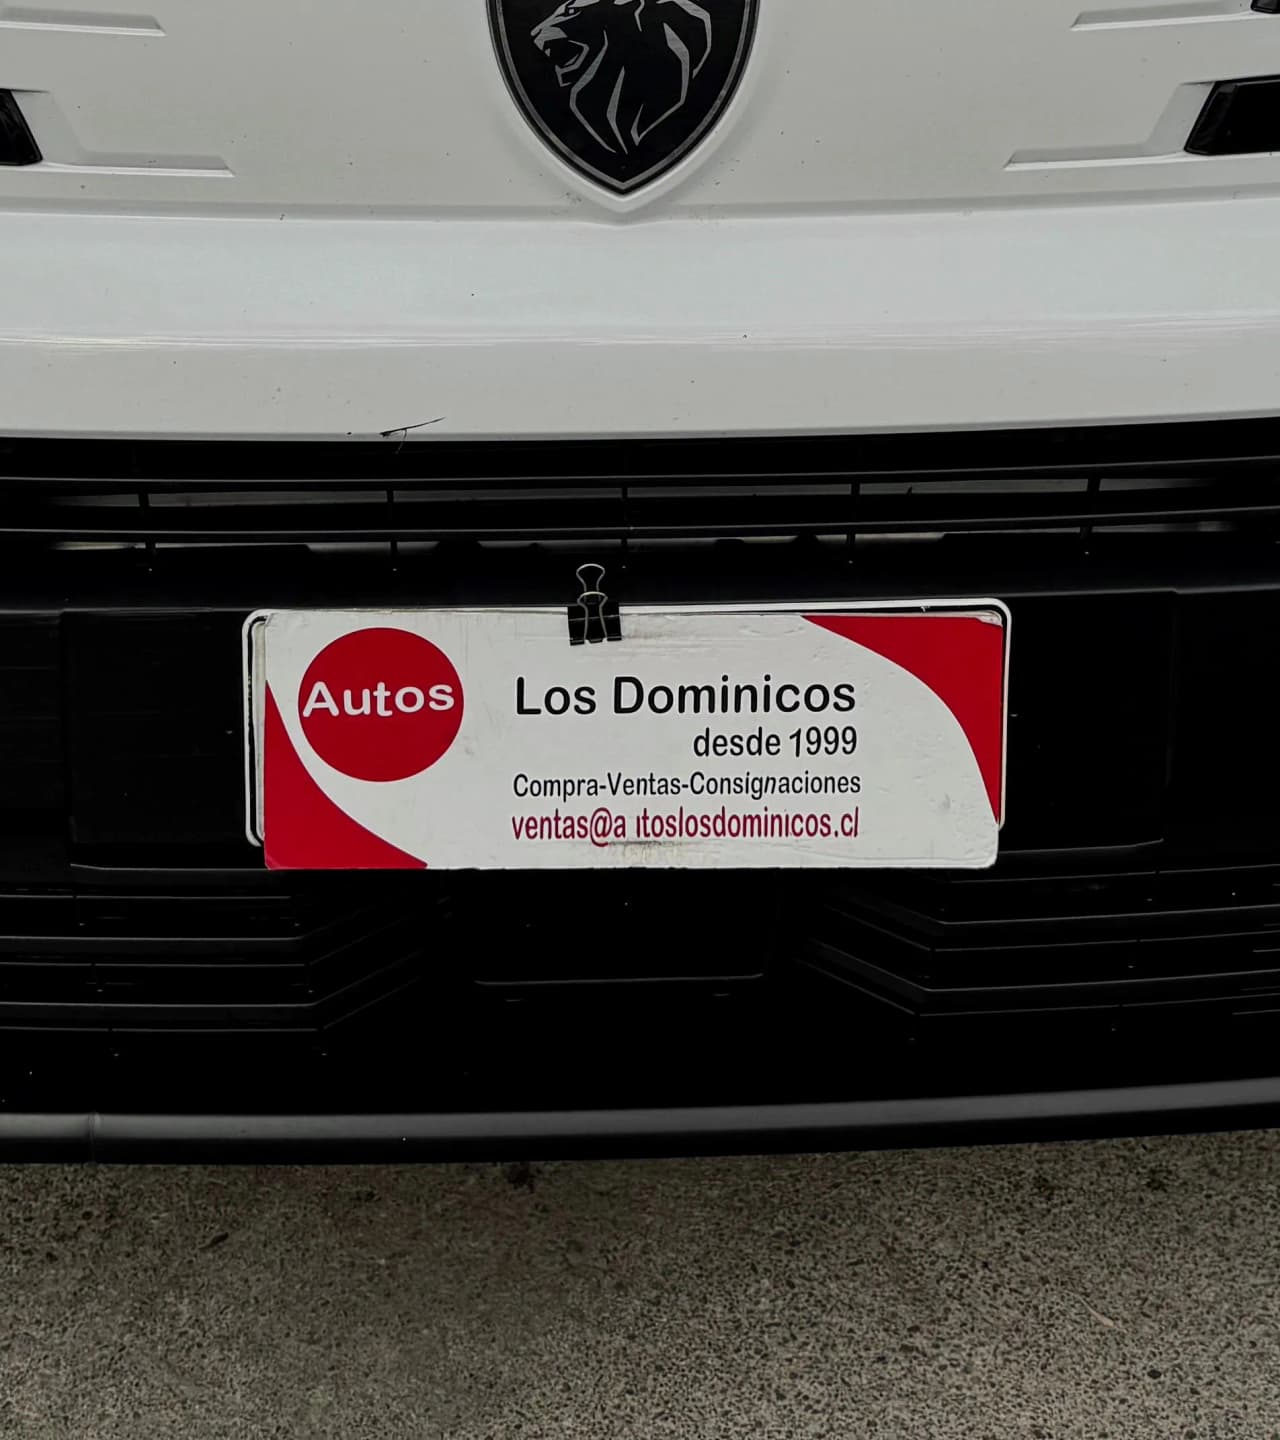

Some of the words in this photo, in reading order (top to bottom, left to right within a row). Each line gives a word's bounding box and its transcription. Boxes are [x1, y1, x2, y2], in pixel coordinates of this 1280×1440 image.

[302, 681, 455, 718] Autos
[516, 676, 597, 715] Los
[613, 674, 856, 715] Dominicos
[693, 726, 781, 757] desde
[789, 725, 858, 758] 1999
[513, 770, 862, 803] Compra-Ventas-Consignaciones
